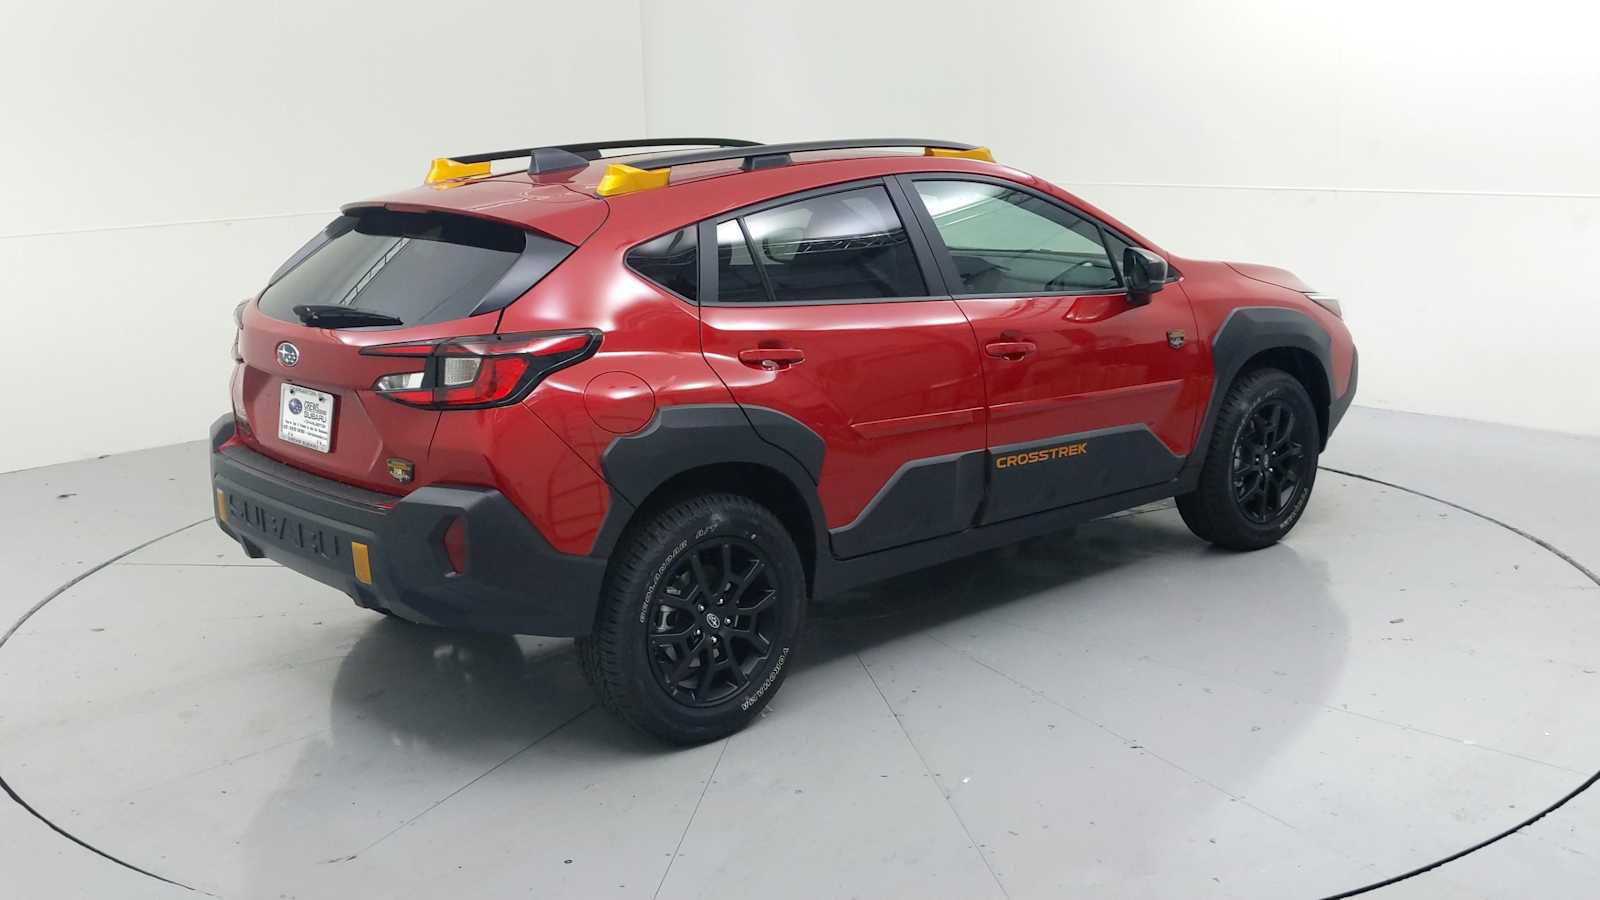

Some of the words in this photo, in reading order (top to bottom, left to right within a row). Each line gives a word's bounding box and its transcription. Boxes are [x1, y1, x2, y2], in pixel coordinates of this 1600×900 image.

[303, 410, 328, 423] SUBARU
[995, 442, 1088, 469] CROSSTREK
[228, 493, 341, 559] SUBARU
[740, 647, 790, 711] YOKOHAMA
